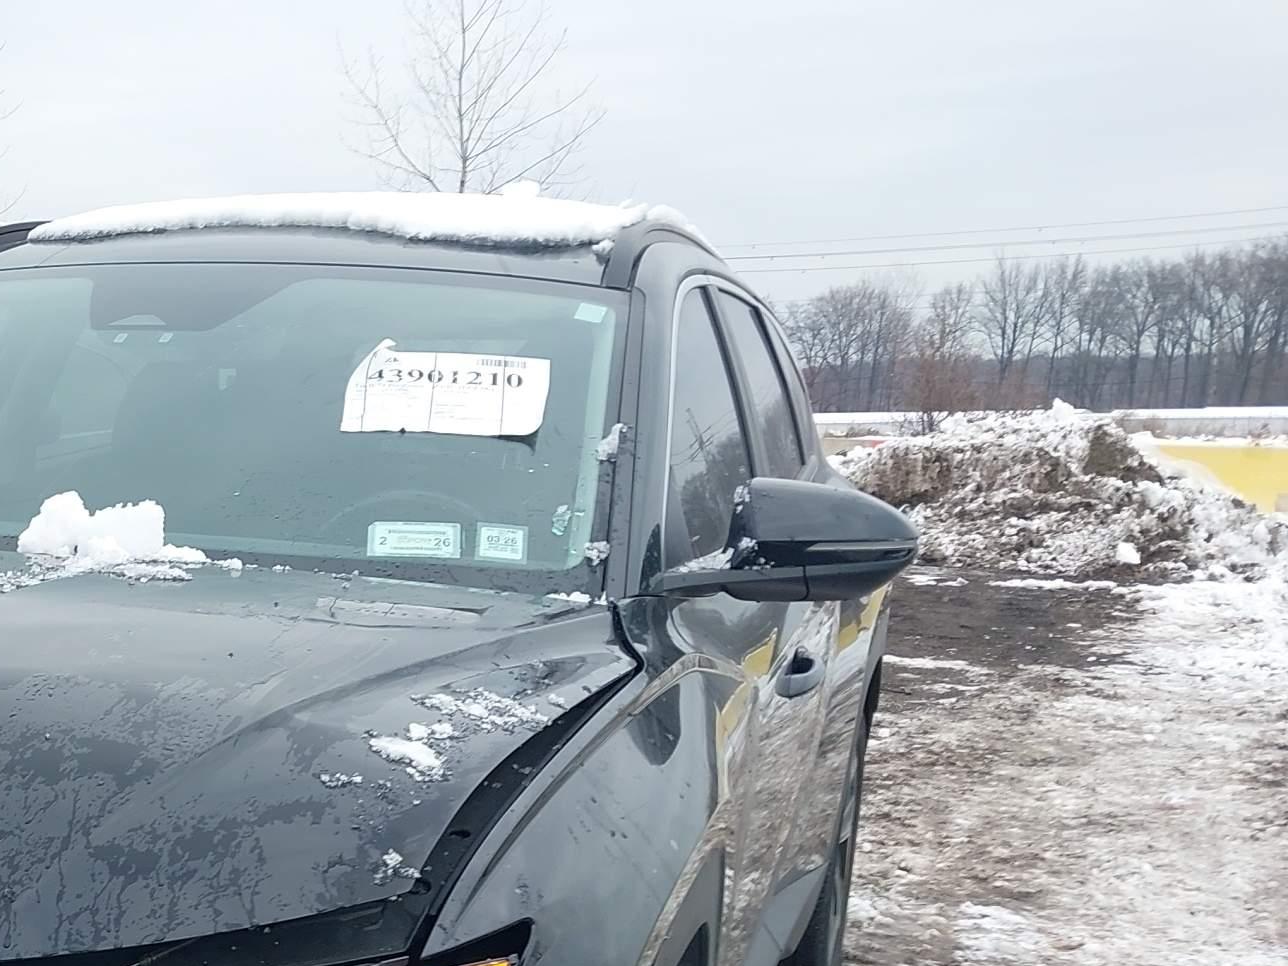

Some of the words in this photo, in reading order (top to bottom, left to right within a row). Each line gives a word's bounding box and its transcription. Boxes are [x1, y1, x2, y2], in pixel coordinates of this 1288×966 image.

[368, 368, 524, 389] 43901210
[378, 536, 388, 546] 2
[433, 537, 451, 548] 26
[504, 536, 518, 545] 26
